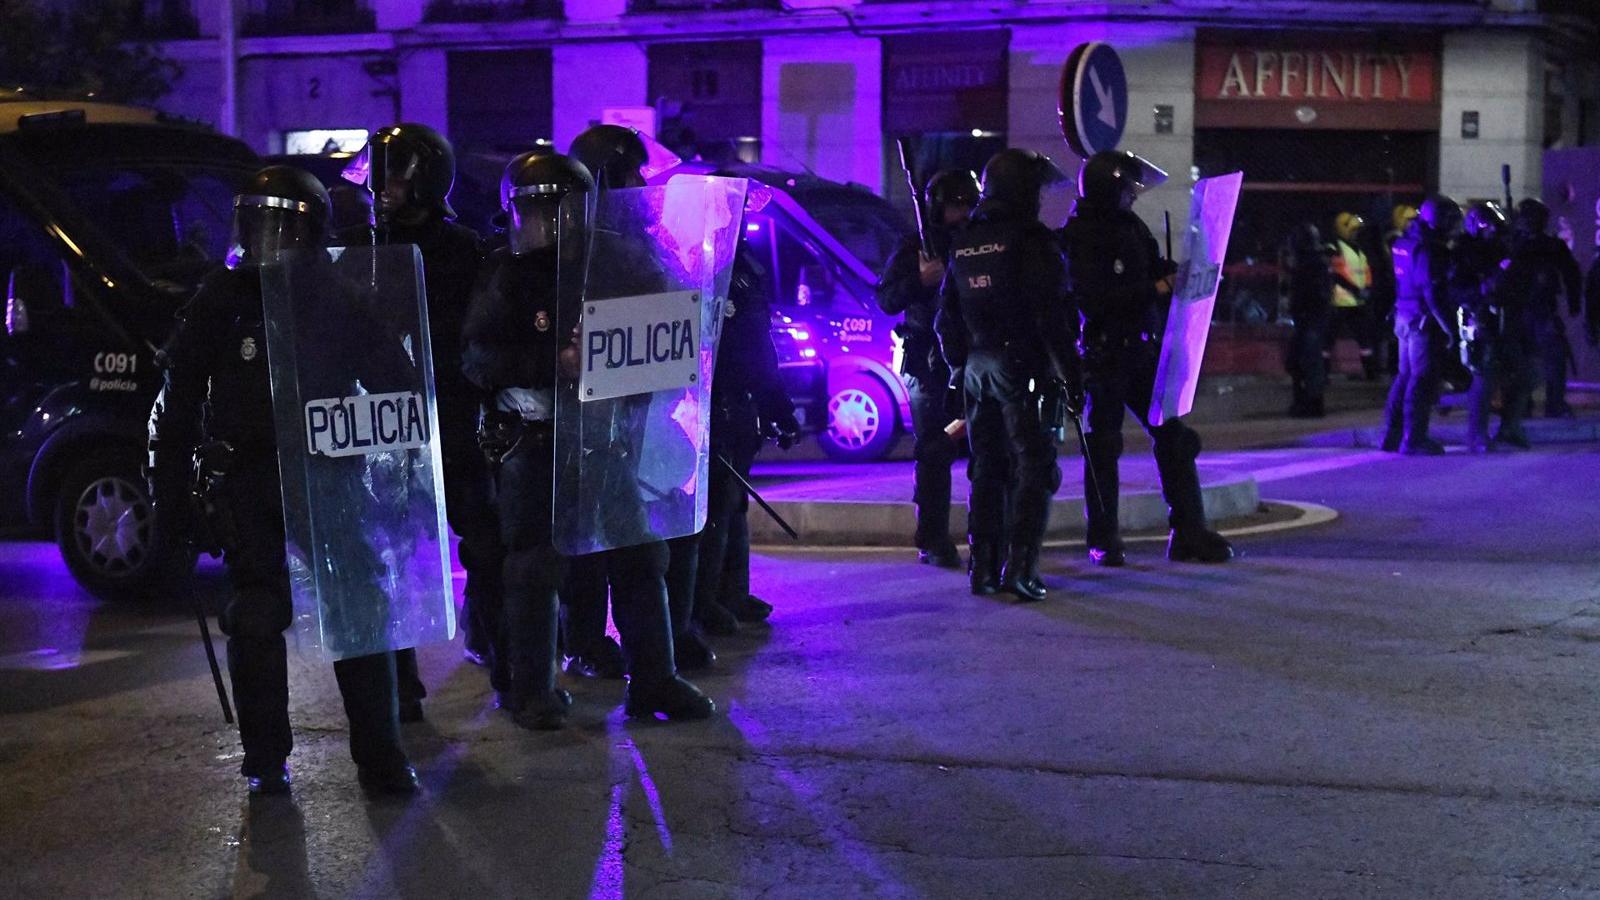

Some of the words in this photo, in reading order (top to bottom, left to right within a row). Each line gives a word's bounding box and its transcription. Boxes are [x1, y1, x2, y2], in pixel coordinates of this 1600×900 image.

[1218, 51, 1415, 99] AFFINITY
[843, 317, 872, 332] C091
[94, 352, 137, 374] C091
[588, 319, 694, 372] POLICIA
[89, 377, 138, 392] @policia
[308, 397, 424, 452] POLICIA
